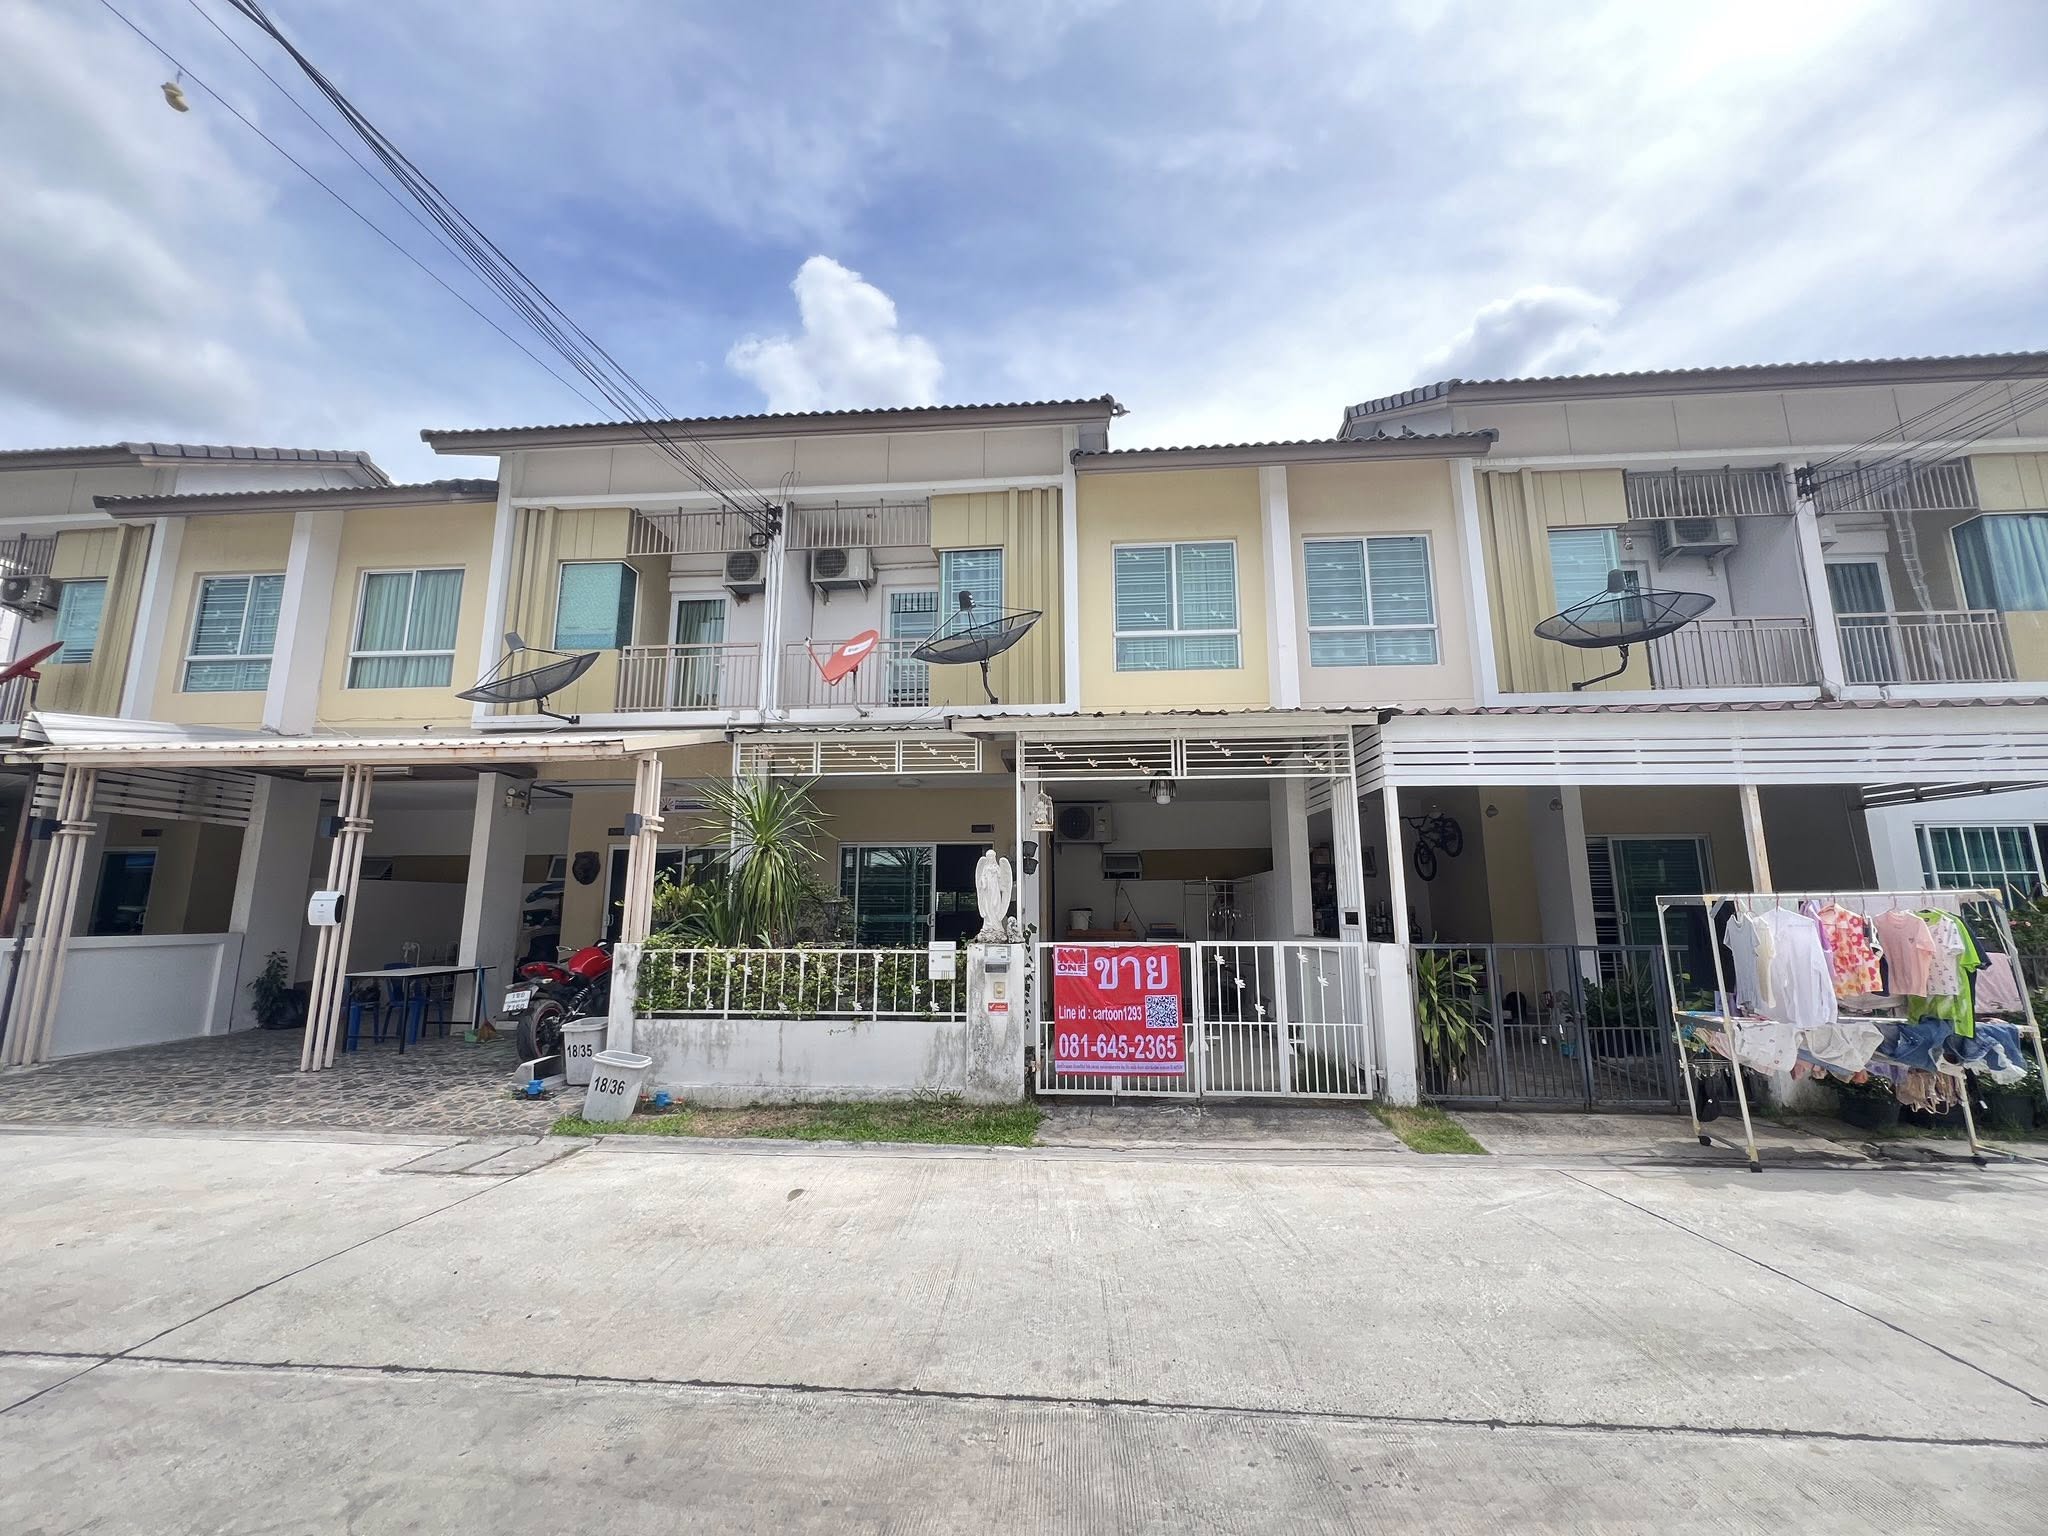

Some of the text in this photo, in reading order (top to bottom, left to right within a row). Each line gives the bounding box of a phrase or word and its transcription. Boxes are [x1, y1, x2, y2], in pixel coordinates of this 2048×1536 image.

[1058, 964, 1086, 972] ONE
[1094, 956, 1168, 990] ขาย
[1059, 1006, 1076, 1019] Line
[1078, 1007, 1086, 1019] id
[1093, 1007, 1142, 1020] cartoon1293
[567, 1044, 593, 1058] 18/35
[1059, 1033, 1177, 1060] 081-645-2365
[594, 1076, 625, 1096] 18/36
